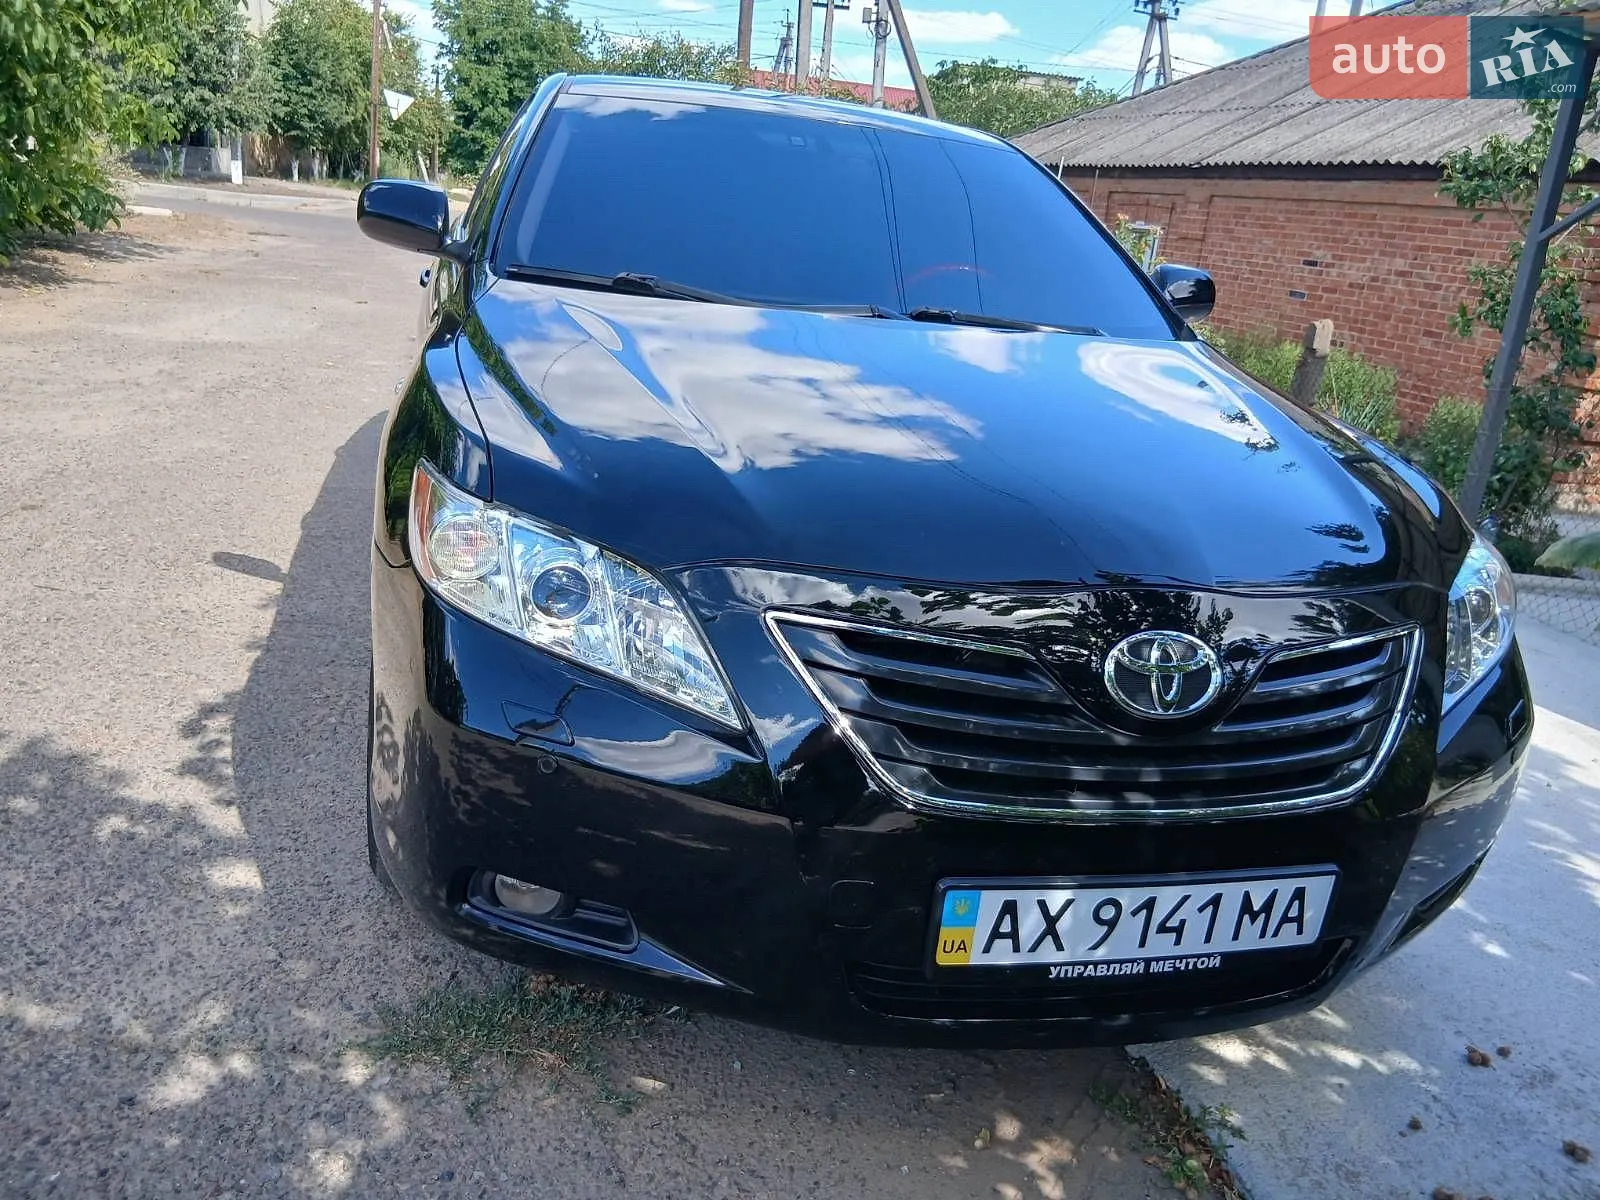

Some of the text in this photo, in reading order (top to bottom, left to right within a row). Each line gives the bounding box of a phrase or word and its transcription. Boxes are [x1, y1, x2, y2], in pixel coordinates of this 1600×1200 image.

[982, 886, 1308, 953] AX 9141 MA
[942, 939, 968, 954] UA
[1048, 954, 1222, 978] УПРАВЛЯЙ МЕЧТОЙ
